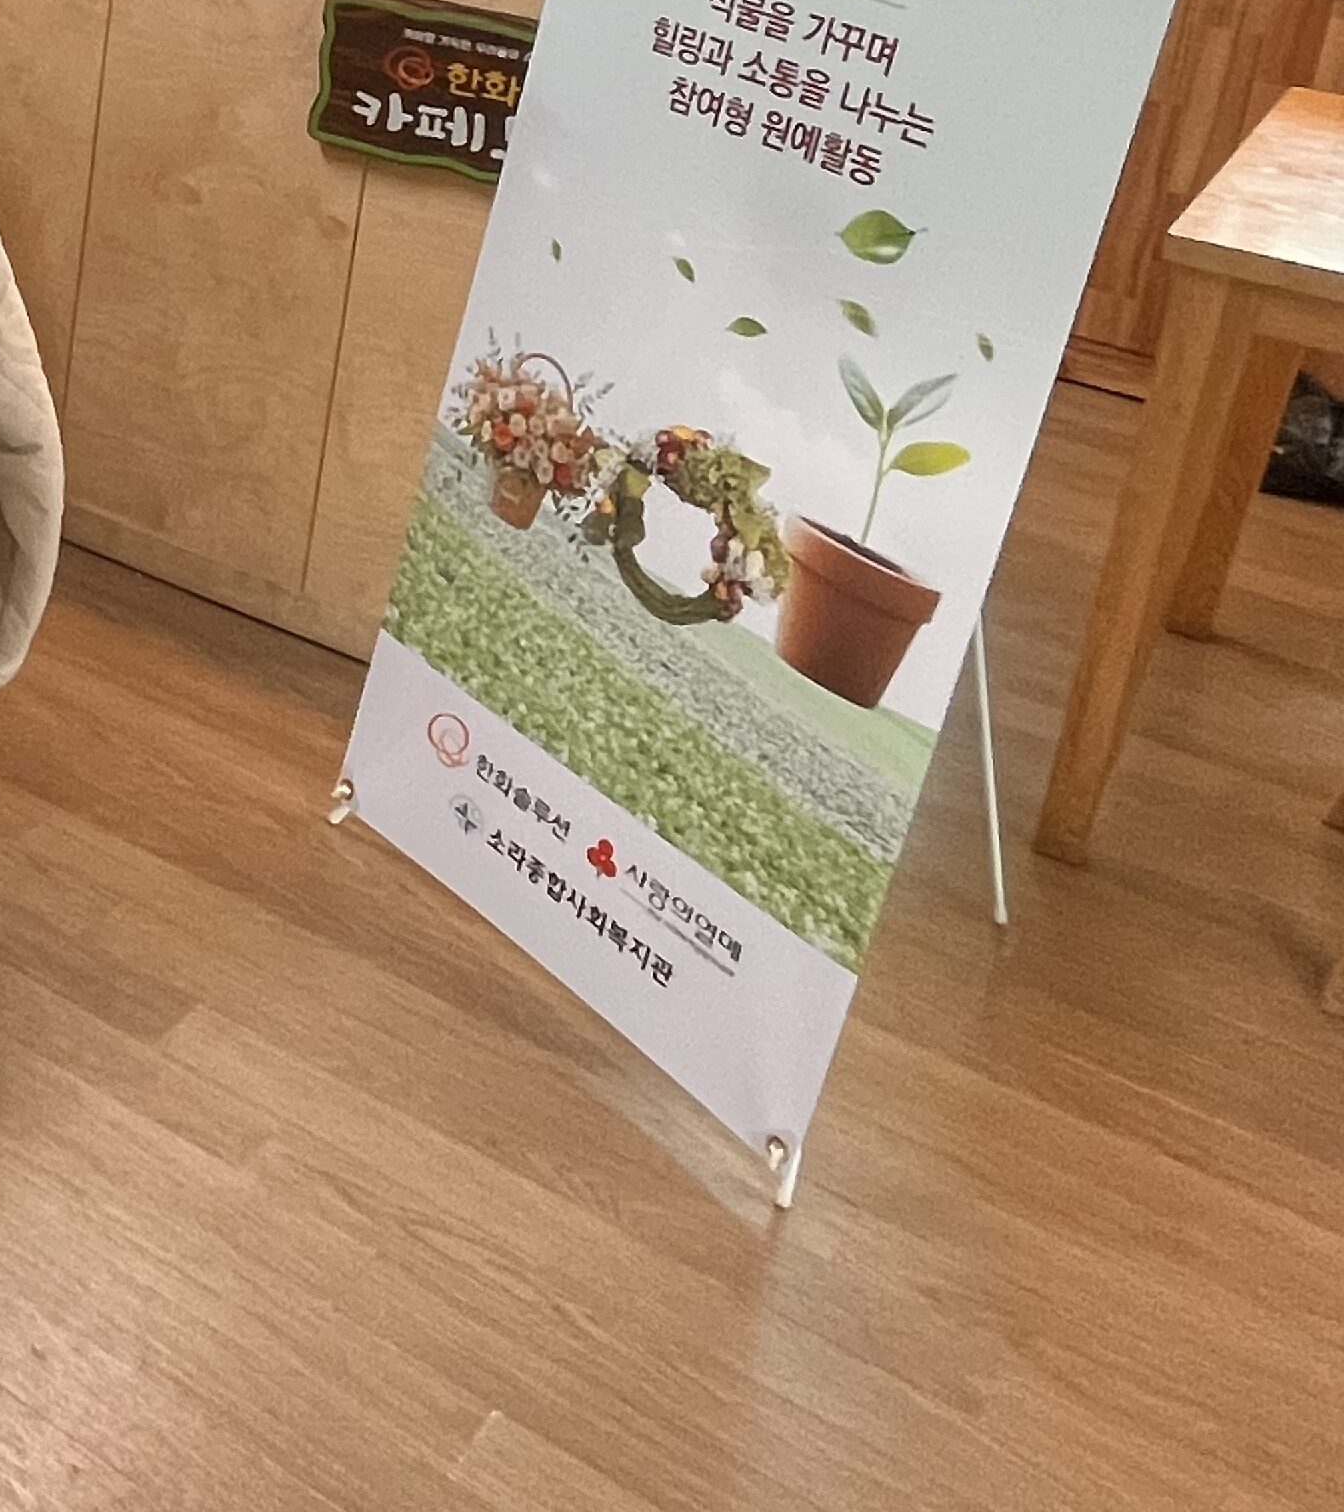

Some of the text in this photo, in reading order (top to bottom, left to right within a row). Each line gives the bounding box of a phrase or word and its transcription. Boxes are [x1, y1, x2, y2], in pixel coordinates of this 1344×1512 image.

[447, 62, 521, 108] 한화
[651, 16, 934, 148] 힐링과 소통을 나누는
[802, 13, 899, 77] 가꾸며
[669, 76, 882, 186] 참여형 원예활동
[487, 829, 673, 987] 소라종합사회복지관
